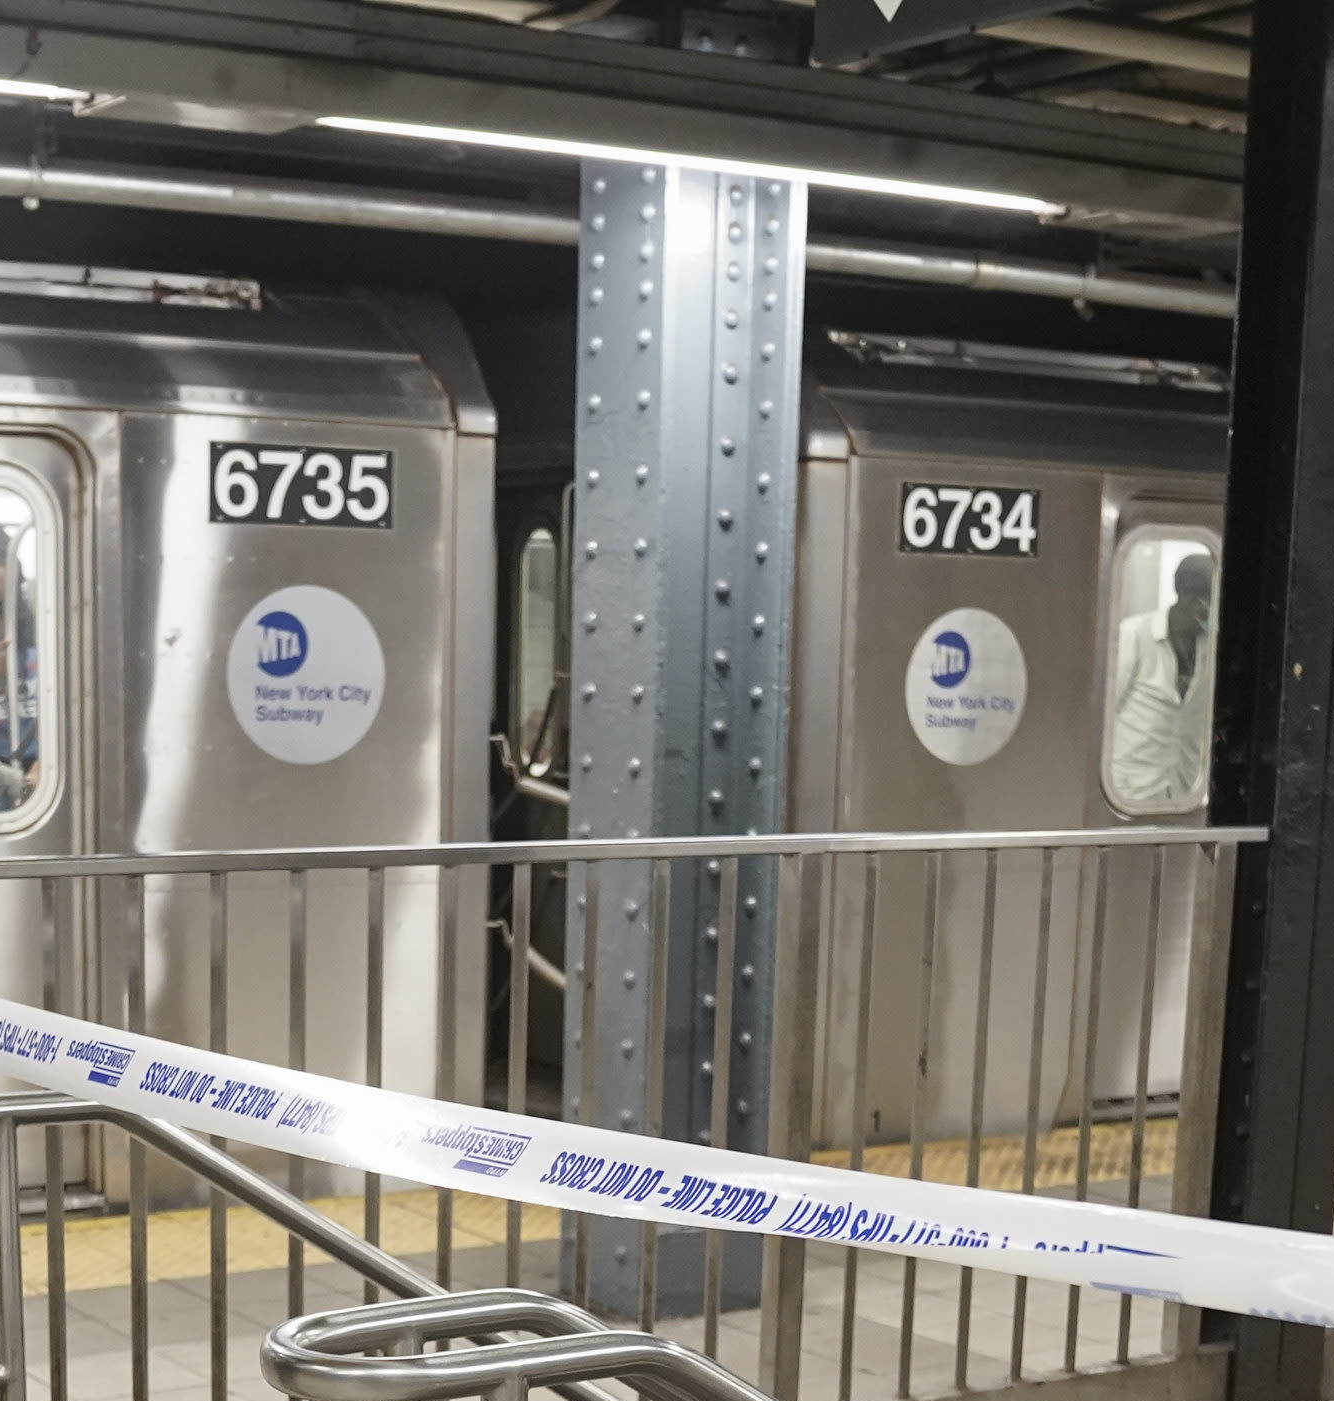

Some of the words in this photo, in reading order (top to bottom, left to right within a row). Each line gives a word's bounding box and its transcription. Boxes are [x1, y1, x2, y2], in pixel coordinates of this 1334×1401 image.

[214, 449, 390, 522] 6735
[903, 487, 1037, 552] 6734
[255, 685, 292, 701] New
[296, 685, 334, 701] York
[338, 685, 372, 705] City
[927, 696, 954, 709] New
[958, 696, 986, 710] York
[990, 695, 1015, 715] City
[255, 705, 325, 727] Subway
[925, 713, 977, 733] Subway
[139, 1061, 180, 1097] CROSS
[168, 1066, 198, 1100] NOT
[189, 1072, 216, 1104] DO
[211, 1079, 246, 1113] LINE
[235, 1084, 283, 1120] POLICE
[540, 1151, 606, 1190] CROSS
[589, 1161, 640, 1197] NOT
[624, 1167, 665, 1202] DO
[660, 1174, 718, 1215] LINE
[711, 1184, 778, 1225] POLICE
[774, 1193, 853, 1241] (8477)
